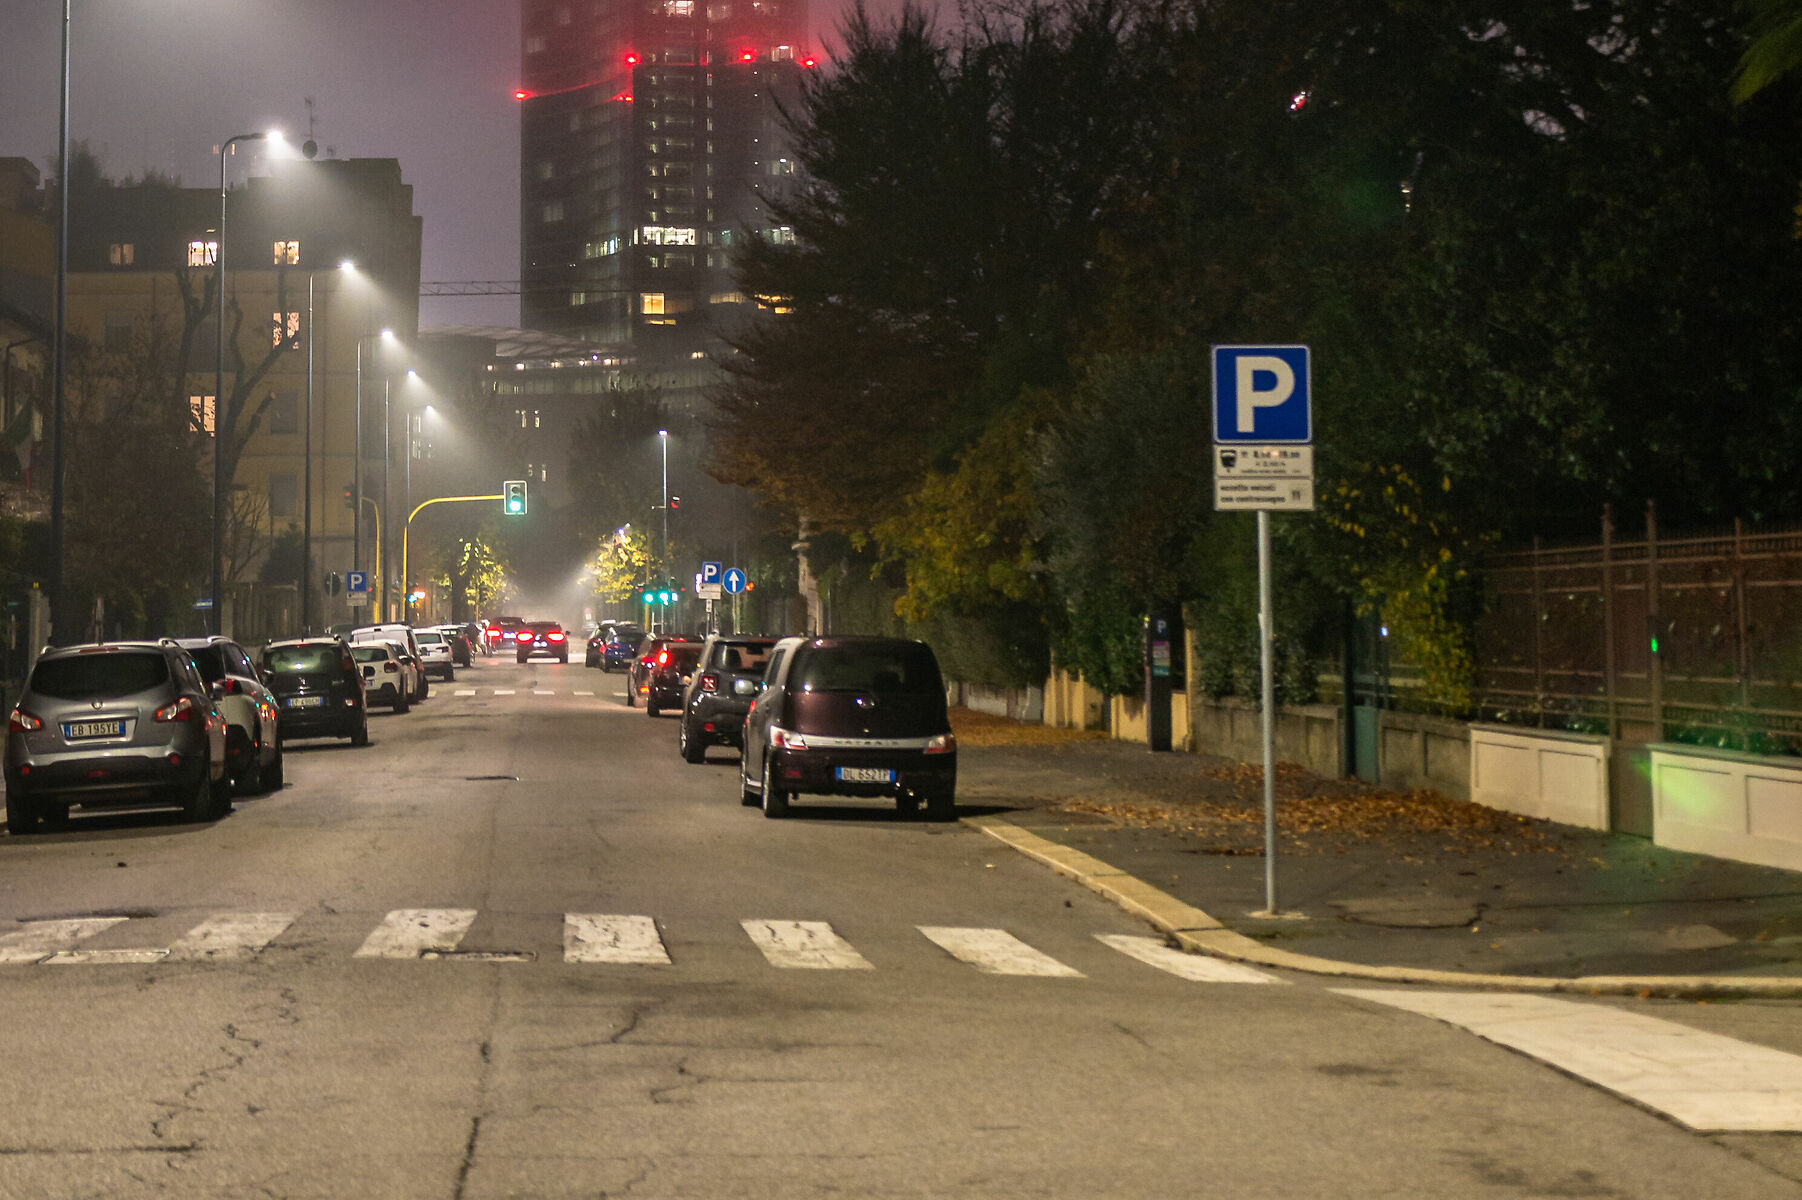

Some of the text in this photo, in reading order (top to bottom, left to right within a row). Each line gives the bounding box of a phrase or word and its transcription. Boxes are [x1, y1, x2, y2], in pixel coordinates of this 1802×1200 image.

[1236, 356, 1295, 433] P
[704, 565, 717, 581] P
[351, 574, 362, 589] P
[1157, 620, 1167, 633] P
[71, 722, 118, 737] EB 195YE
